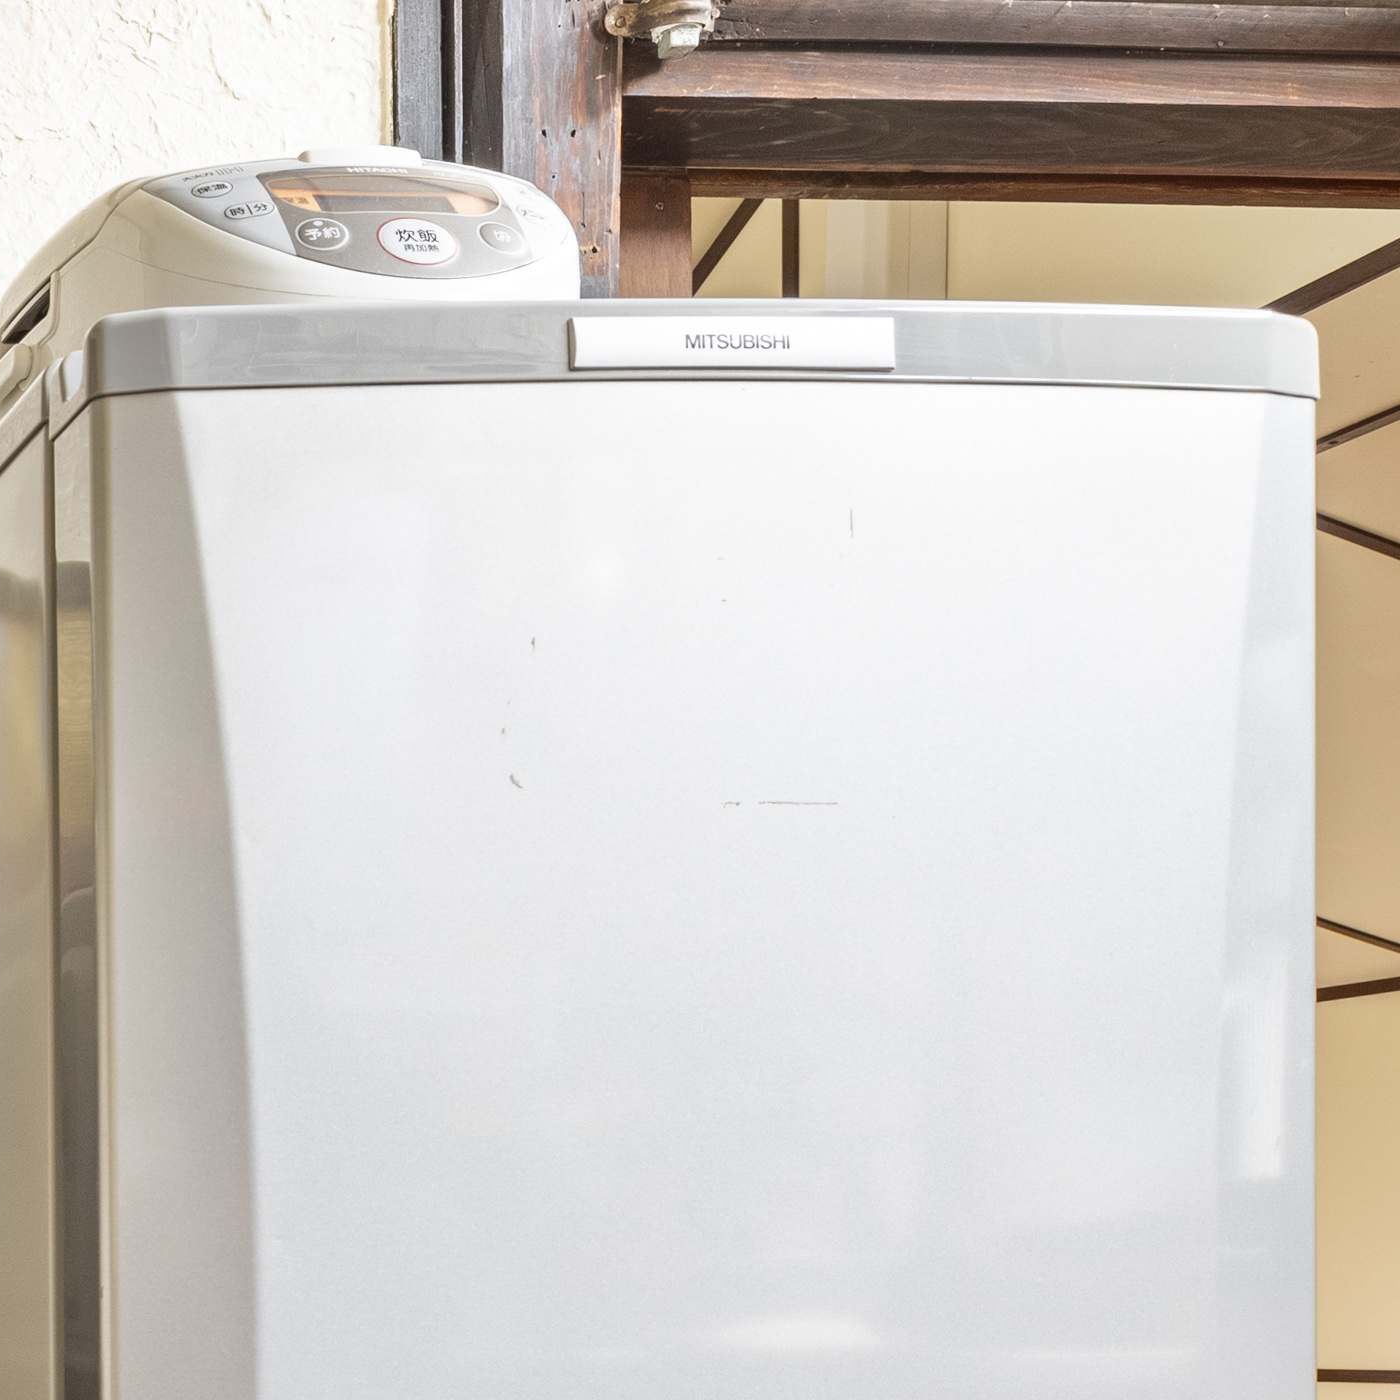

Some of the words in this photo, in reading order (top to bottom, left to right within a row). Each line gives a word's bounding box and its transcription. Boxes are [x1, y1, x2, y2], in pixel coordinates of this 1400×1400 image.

[347, 166, 409, 175] HITACHI
[197, 183, 229, 195] 保温
[304, 226, 341, 241] 予約
[395, 228, 439, 243] 炊飯
[403, 243, 440, 252] 再加熱
[684, 333, 791, 350] MITSUBISHI
